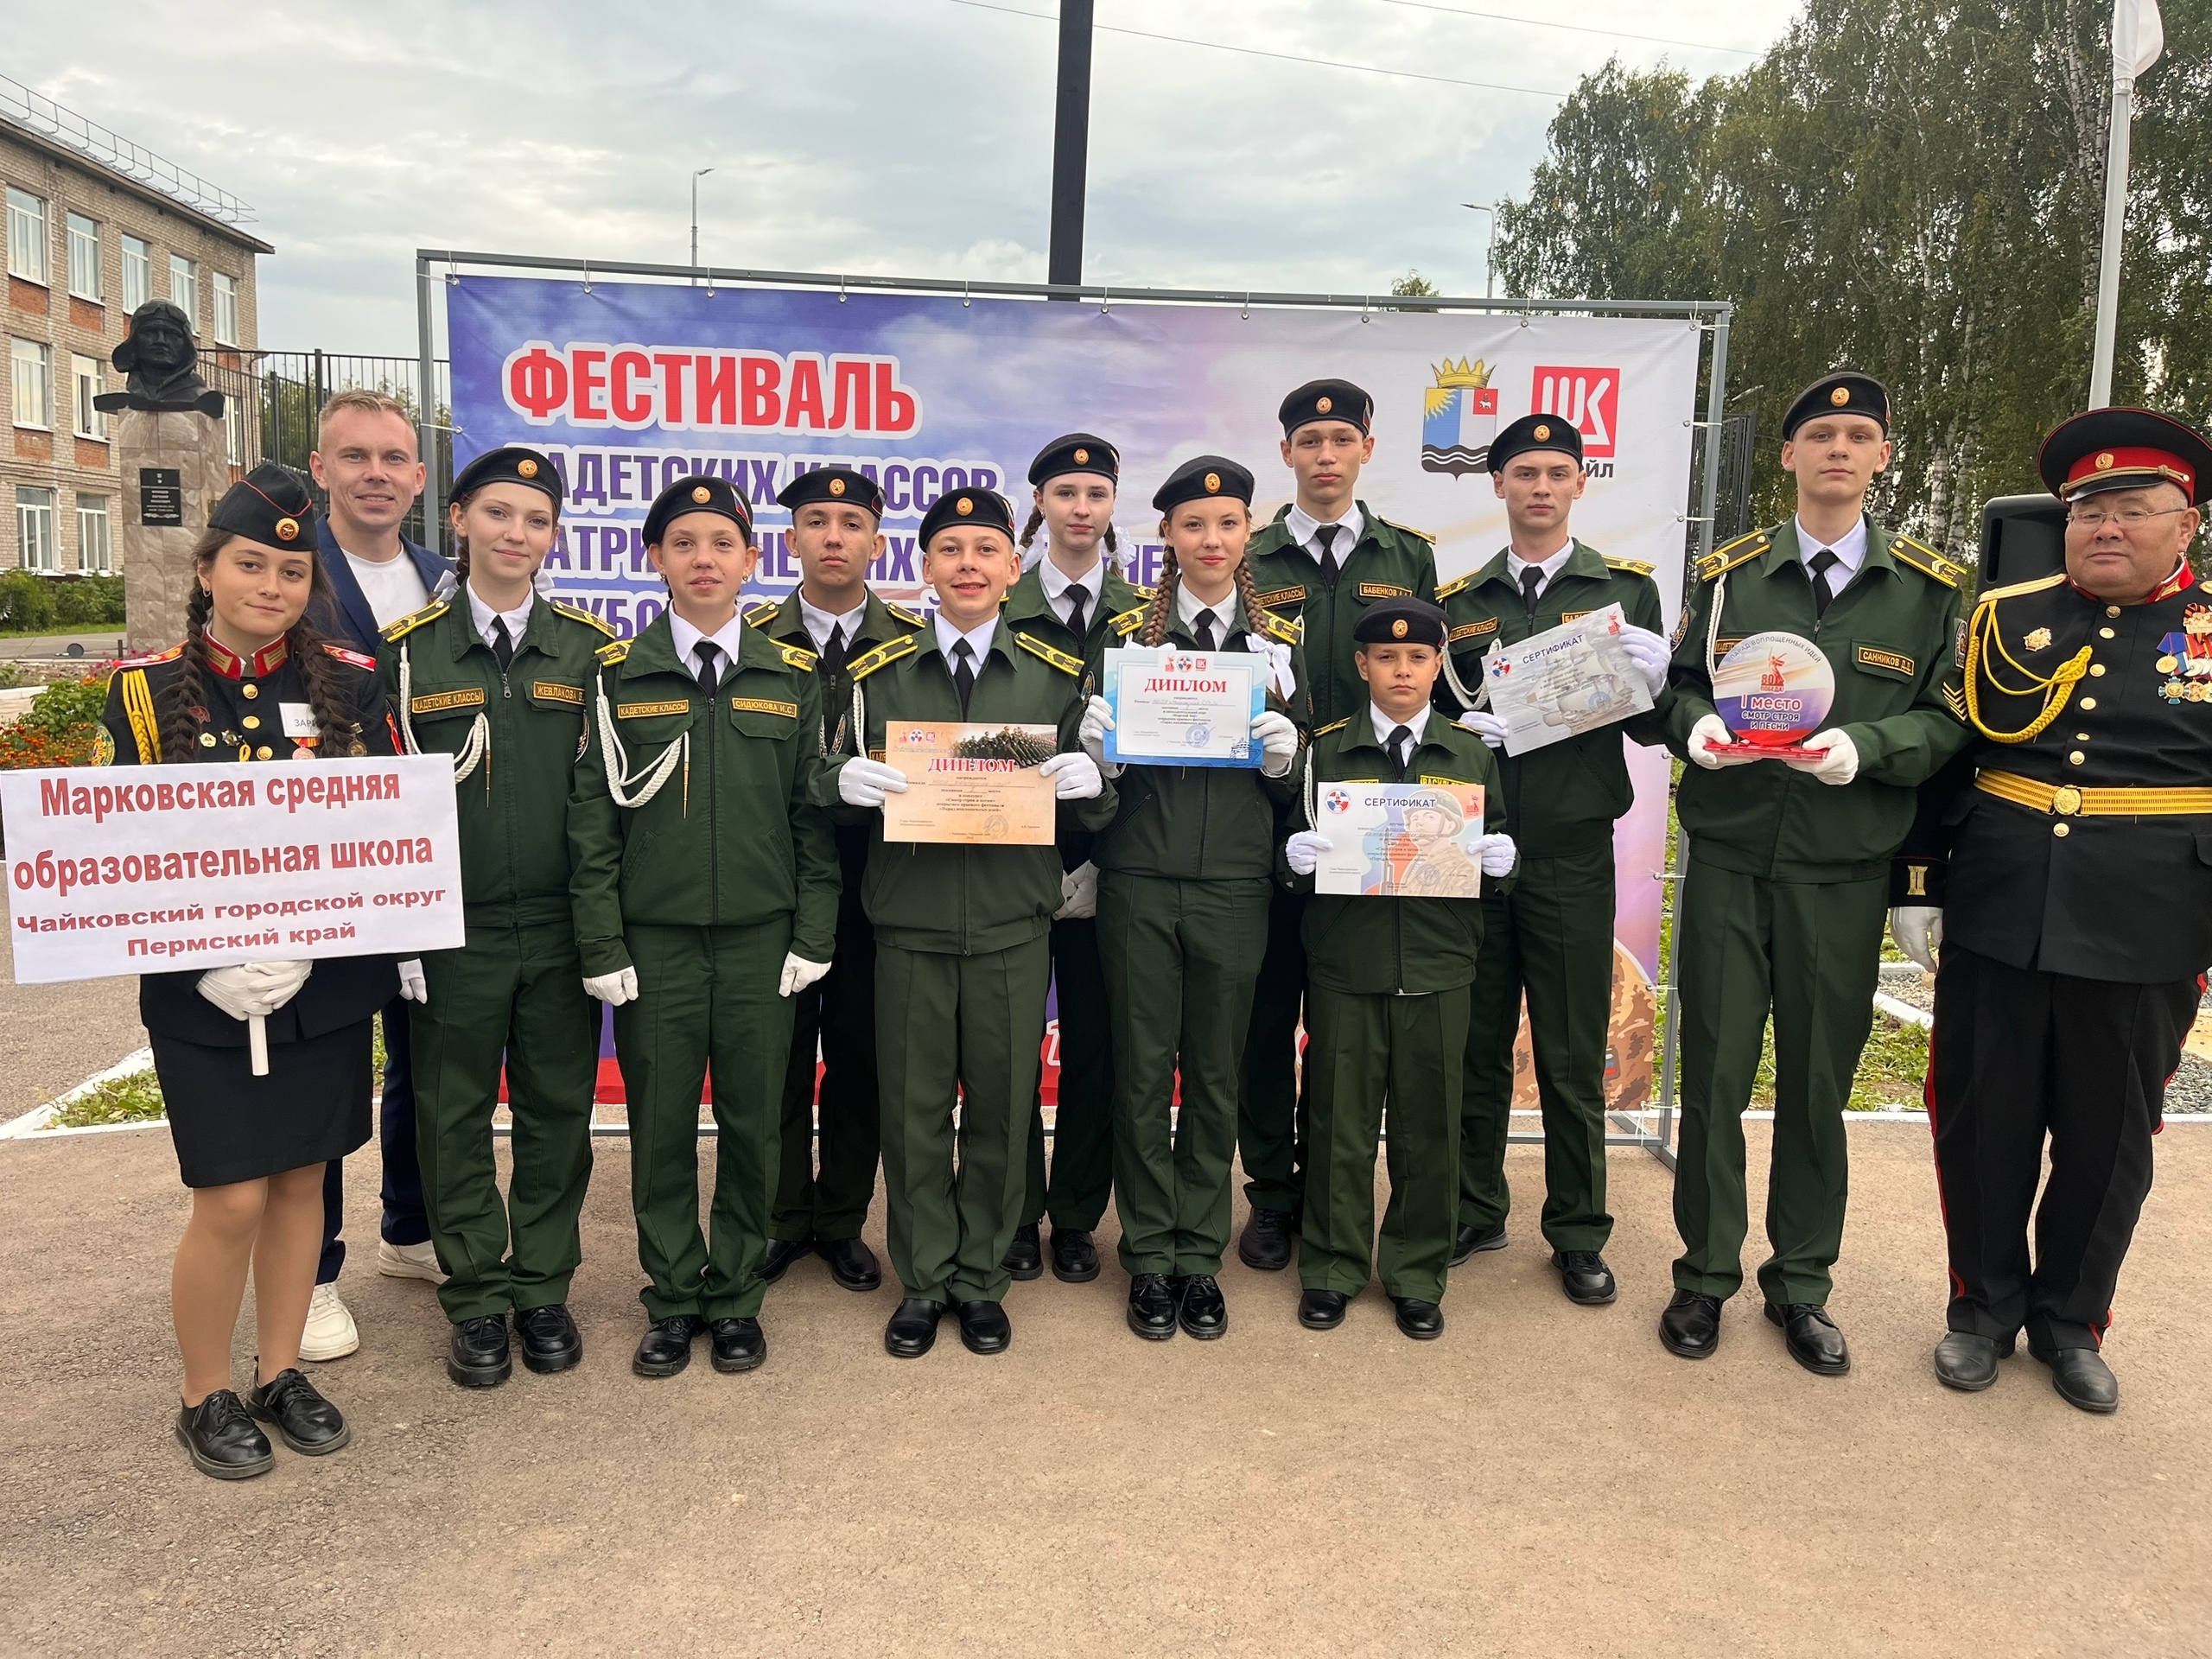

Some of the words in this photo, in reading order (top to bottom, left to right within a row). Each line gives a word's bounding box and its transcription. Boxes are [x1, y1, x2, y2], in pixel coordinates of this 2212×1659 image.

[508, 347, 918, 434] ФЕСТИВАЛЬ
[1363, 586, 1397, 596] БАБЕНКОВ
[1522, 634, 1585, 665] СЕРТИФИКАТ
[1730, 643, 1751, 660] ПАРАД
[1751, 635, 1805, 650] ВОПЛОЩЕННЫХ
[1803, 647, 1822, 664] ИДЕЙ
[1862, 651, 1899, 667] САННИКОВ
[1144, 678, 1228, 693] ДИПЛОМ
[1761, 674, 1775, 684] 80
[415, 695, 452, 710] КАДЕТСКИЕ
[453, 691, 481, 704] КЛАССЫ
[537, 685, 577, 701] ЖЕВЛАКОВА
[620, 704, 658, 715] КАДЕТСКИЕ
[659, 702, 688, 714] КЛАССЫ
[735, 700, 779, 712] СИДЮКОВА
[779, 703, 795, 715] И.С.
[1772, 712, 1800, 721] СТРОЯ
[928, 758, 1015, 772] ДИПЛОМ
[40, 777, 257, 823] Марковская
[266, 772, 401, 814] средняя
[1364, 798, 1436, 808] СЕРТИФИКАТ
[13, 843, 321, 897] образовательная
[330, 836, 433, 869] школа
[16, 903, 206, 934] Чайковский
[213, 891, 364, 918] городской
[372, 888, 448, 912] округ
[127, 928, 280, 958] Пермский
[289, 921, 357, 946] край
